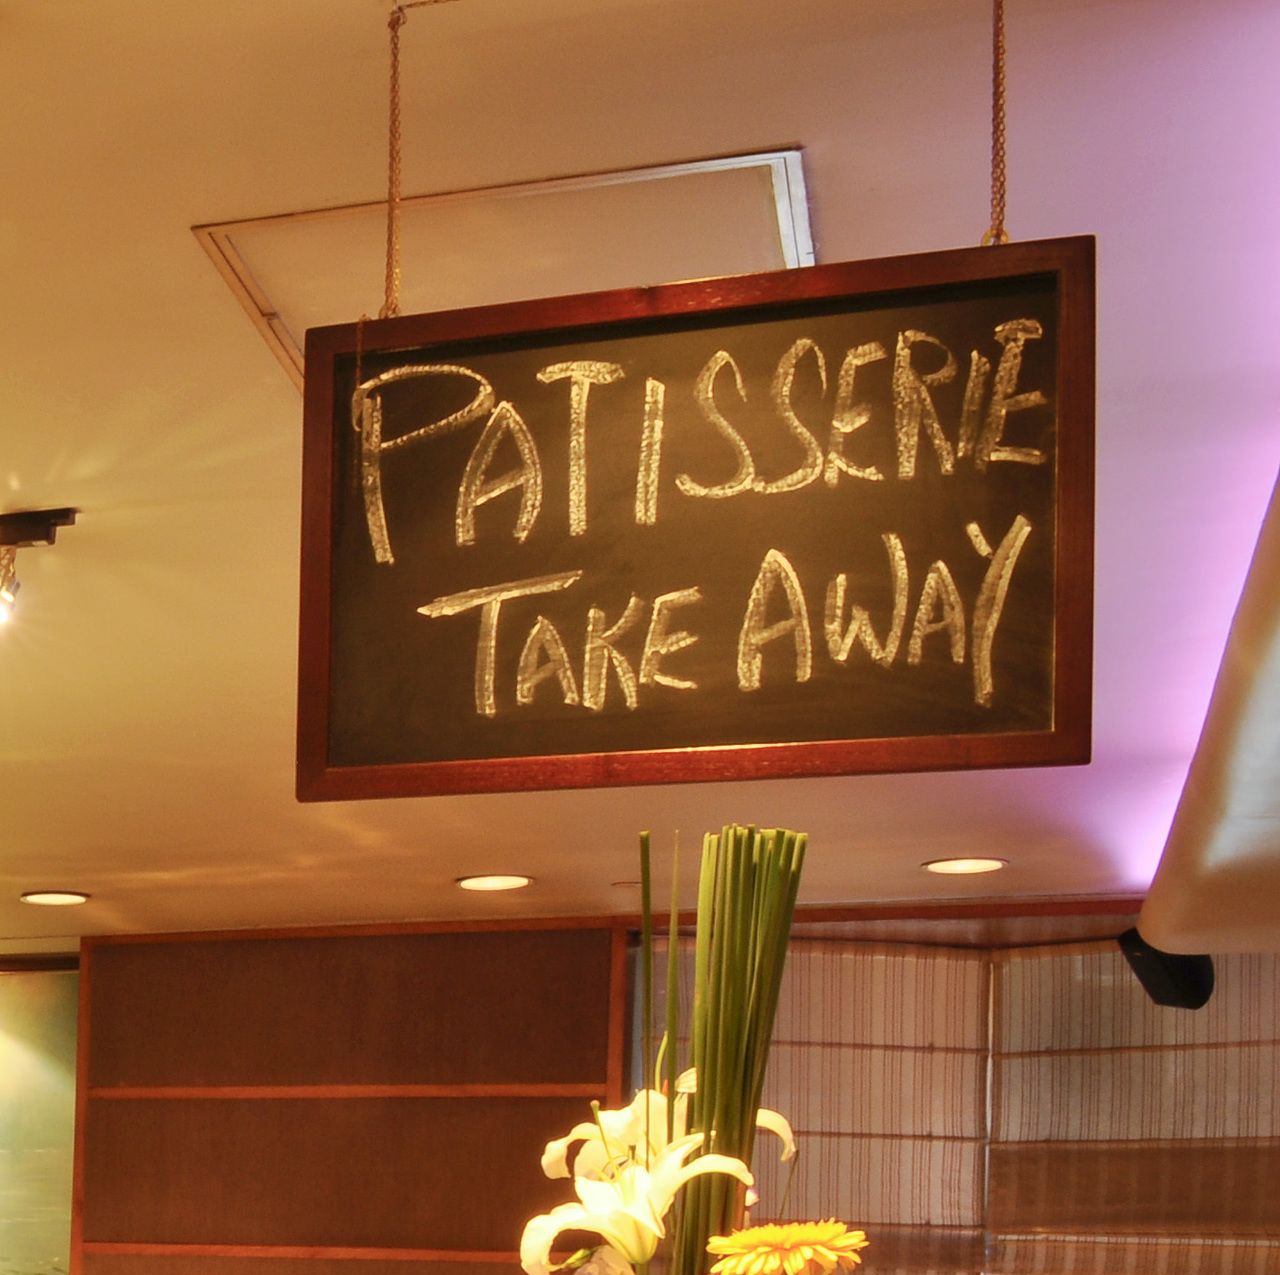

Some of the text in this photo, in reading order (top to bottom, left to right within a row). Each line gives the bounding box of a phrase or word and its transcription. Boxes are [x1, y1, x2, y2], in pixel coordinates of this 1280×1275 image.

[353, 319, 1046, 565] PATISSERIE
[417, 514, 1032, 719] TAKE AWAY
